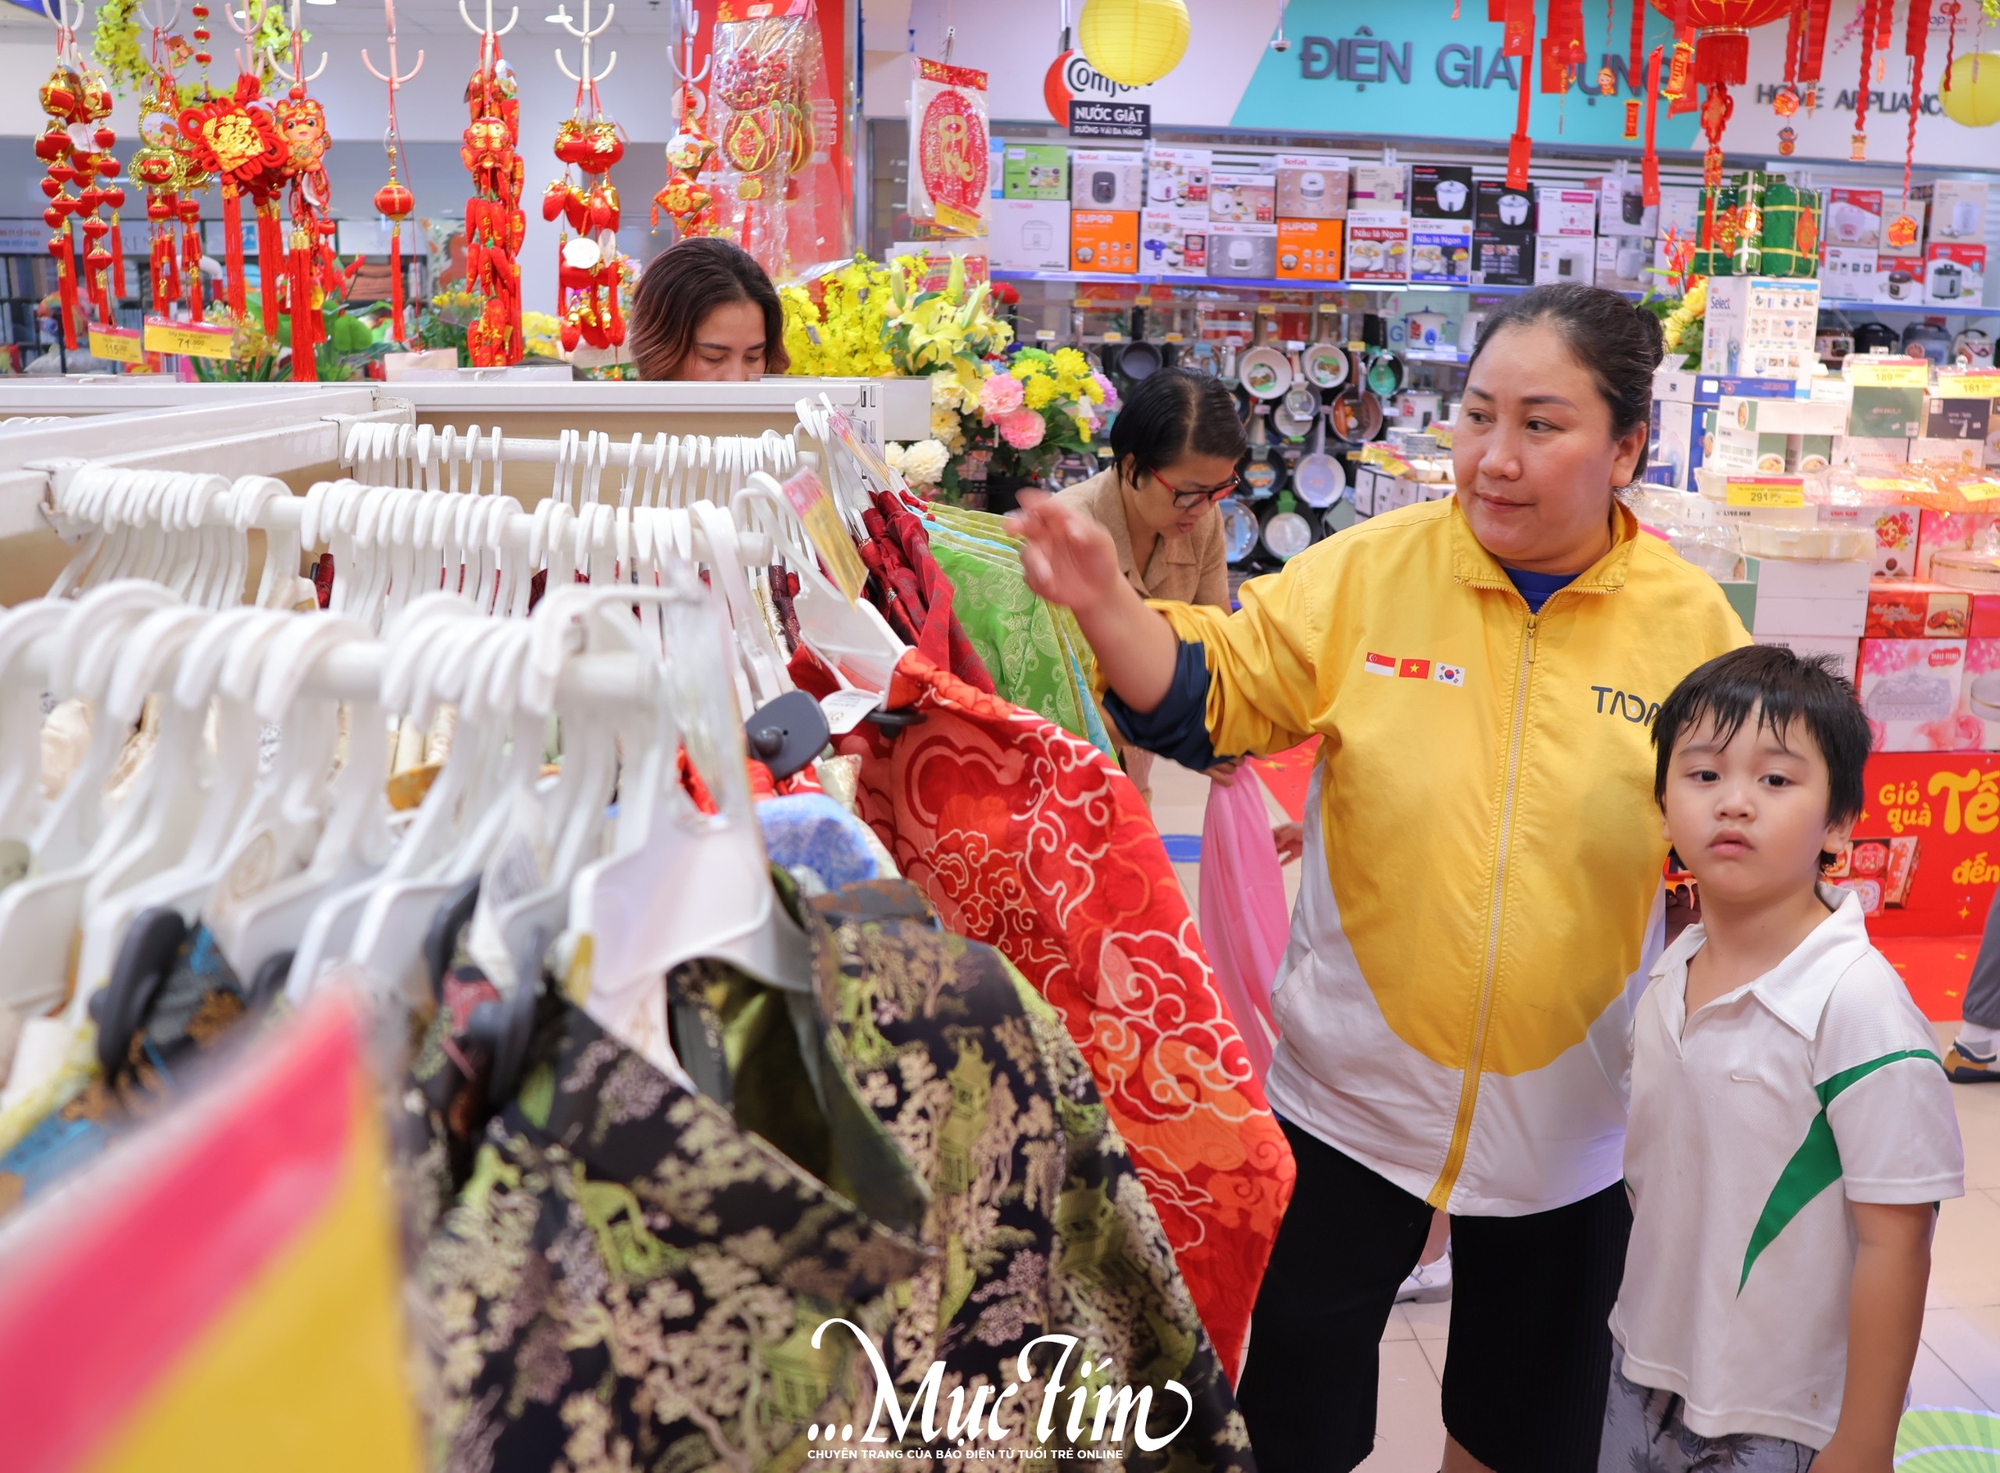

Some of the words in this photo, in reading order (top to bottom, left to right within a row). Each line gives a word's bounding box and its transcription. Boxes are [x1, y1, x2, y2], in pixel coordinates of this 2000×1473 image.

[1300, 25, 1412, 92] ĐIỆN
[1436, 44, 1519, 91] GIA
[1113, 106, 1145, 124] GIẶT
[1282, 158, 1308, 166] Tefal
[1075, 214, 1114, 224] SUPOR
[1280, 222, 1318, 232] SUPOR
[1711, 295, 1731, 310] Select
[1879, 780, 1920, 806] Giỏ
[1887, 802, 1932, 834] quà
[1952, 851, 2000, 886] đến
